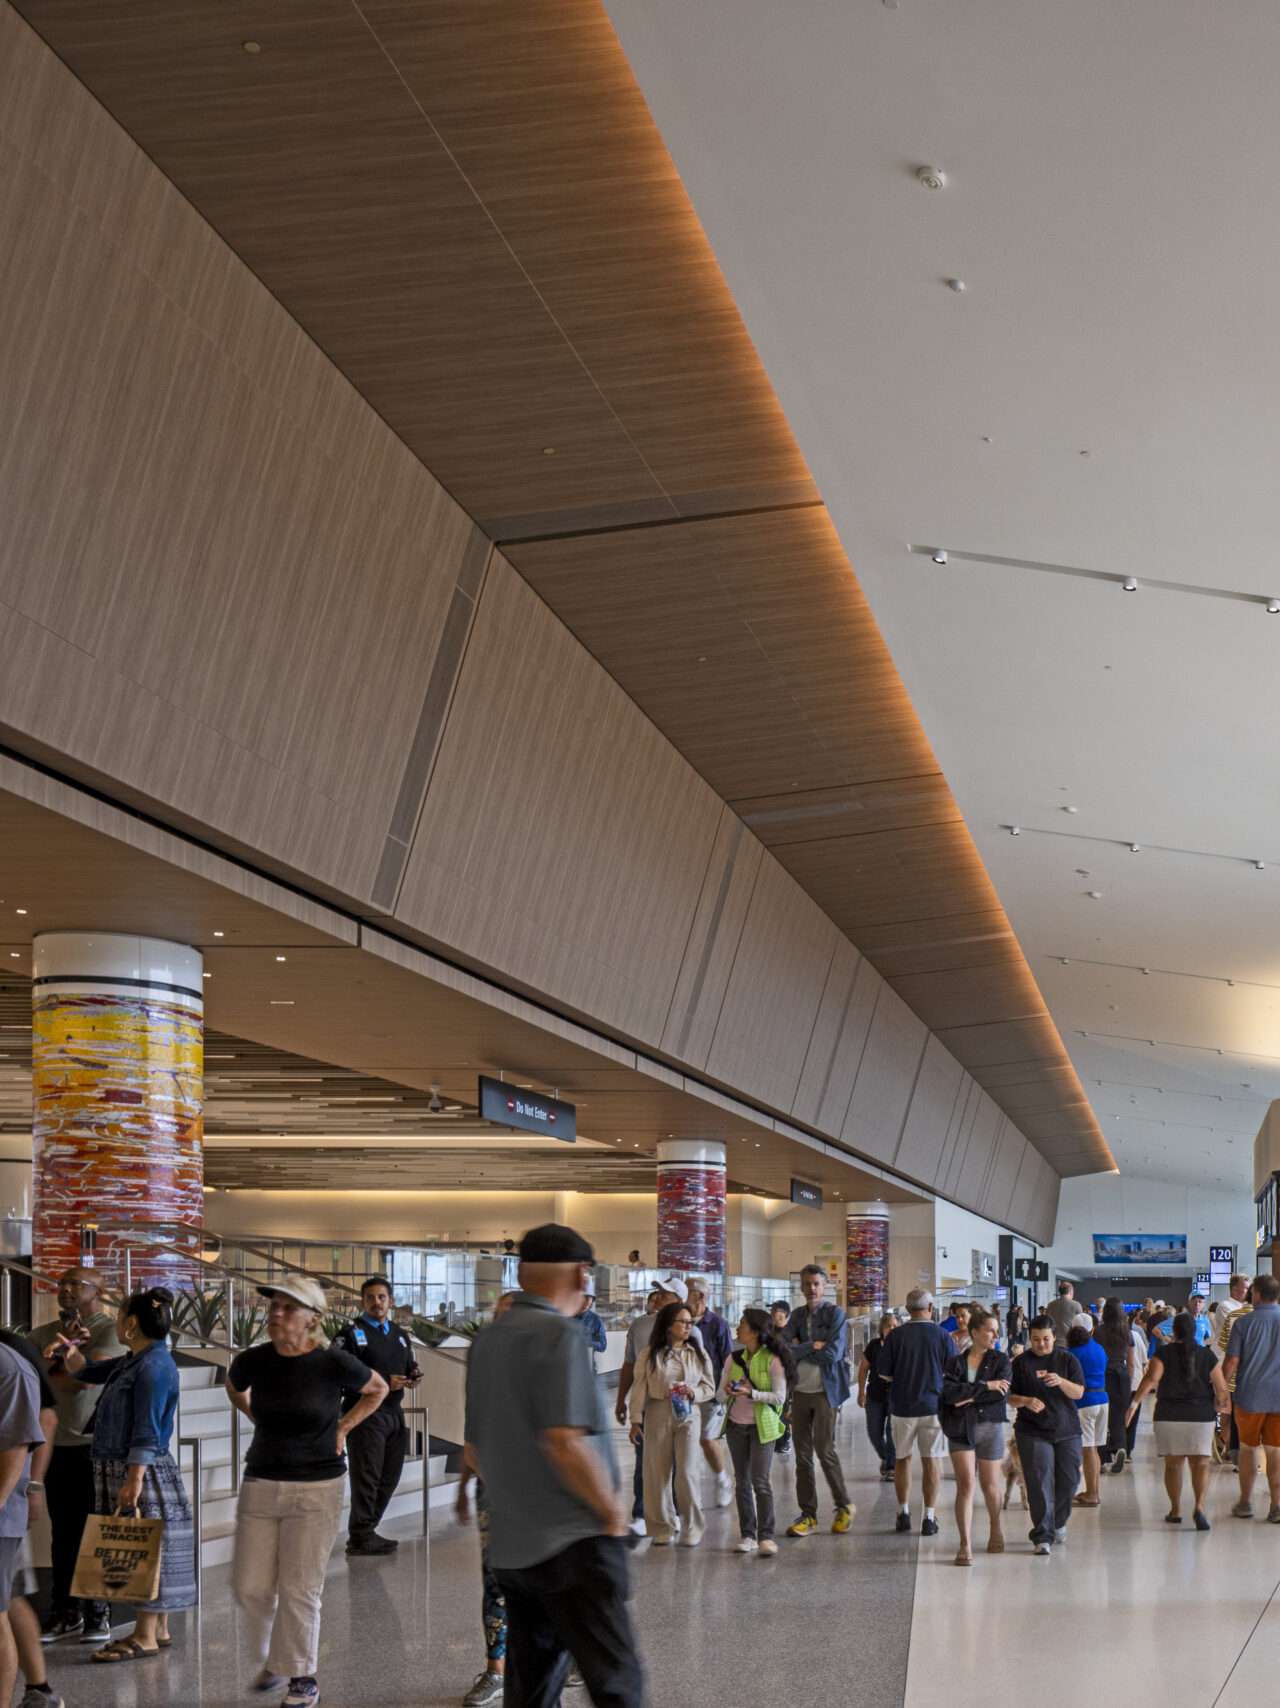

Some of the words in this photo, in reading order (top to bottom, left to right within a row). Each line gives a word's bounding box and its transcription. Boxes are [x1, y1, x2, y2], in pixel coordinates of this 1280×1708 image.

[516, 1101, 524, 1114] Do
[524, 1104, 534, 1117] Not
[534, 1107, 547, 1120] Enter
[1211, 1249, 1231, 1259] 120
[99, 1524, 122, 1533] THE
[124, 1525, 154, 1534] BEST
[101, 1532, 148, 1542] SNACKS
[95, 1548, 148, 1561] BETTER
[102, 1558, 138, 1571] WITH
